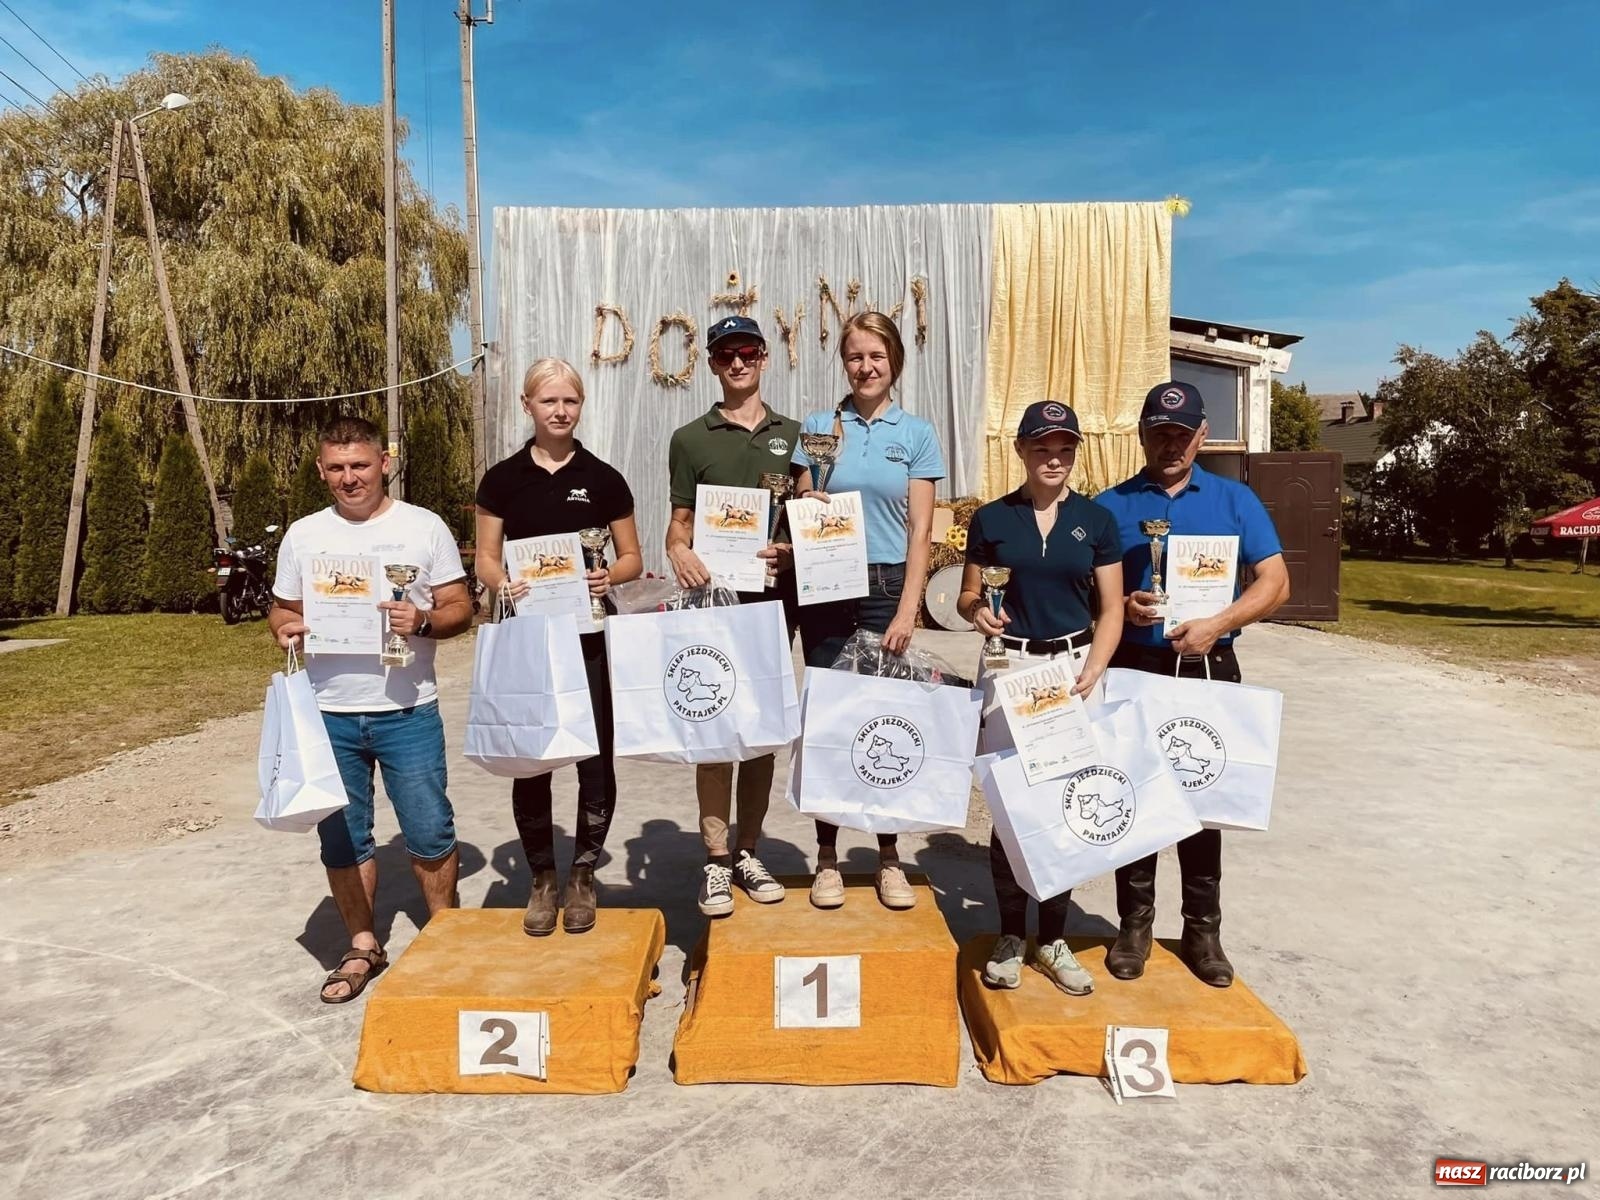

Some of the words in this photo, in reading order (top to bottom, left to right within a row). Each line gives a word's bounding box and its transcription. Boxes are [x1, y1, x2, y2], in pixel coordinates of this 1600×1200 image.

[589, 270, 928, 391] DOYNI
[705, 490, 763, 511] DYPLOM
[796, 497, 856, 520] DYPLOM
[514, 538, 576, 561] DYPLOM
[1176, 541, 1233, 558] DYPLOM
[311, 558, 374, 577] DYPLOM
[667, 653, 685, 678] SKLEP
[1004, 664, 1068, 698] DYPLOM
[673, 695, 728, 718] PATATAJEK.PL
[858, 721, 879, 743] SKLEP
[1158, 722, 1177, 739] KLEP
[858, 764, 914, 785] PATATAJEK.PL
[1065, 781, 1077, 810] SKLEP
[1082, 807, 1132, 842] PATATAJEK.PL
[802, 963, 828, 1019] 1
[479, 1018, 519, 1066] 2
[1120, 1039, 1165, 1093] 3
